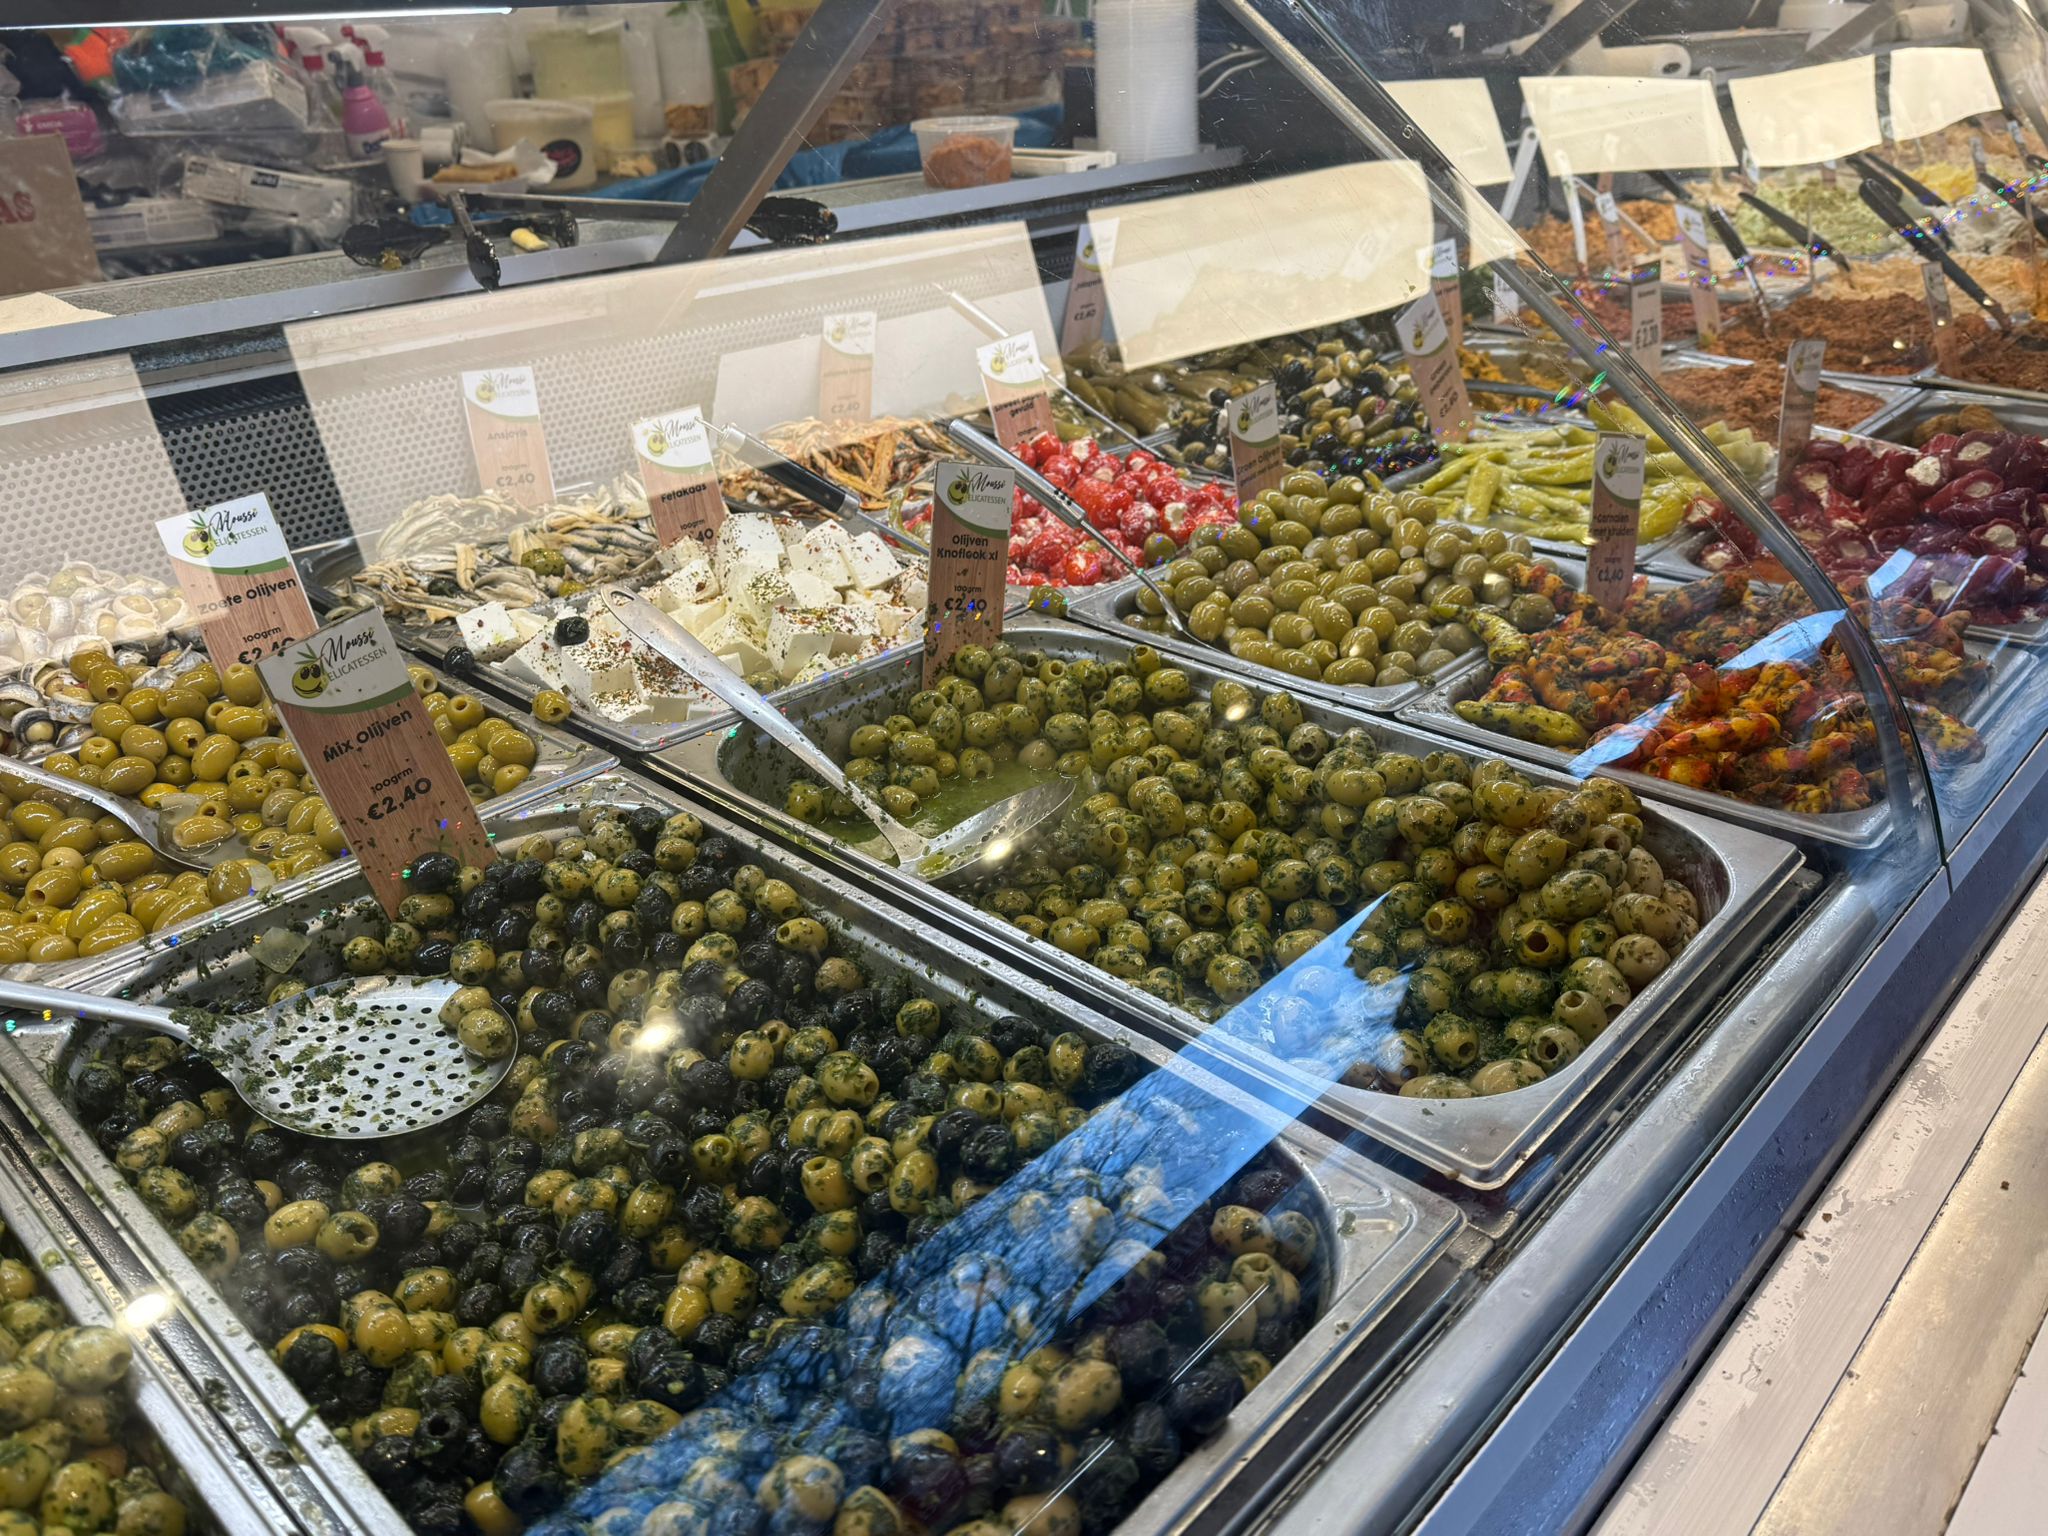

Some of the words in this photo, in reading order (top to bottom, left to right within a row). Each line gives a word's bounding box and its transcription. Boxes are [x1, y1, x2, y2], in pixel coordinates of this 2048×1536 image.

[495, 472, 536, 487] €2,40
[968, 471, 1006, 493] Moussi
[660, 482, 707, 503] Fetakaas
[208, 508, 258, 537] Moussi
[952, 535, 988, 547] Olijven
[936, 548, 987, 561] Knoflook
[197, 594, 243, 615] Zoete
[246, 577, 298, 600] Olijven
[953, 585, 982, 594] 100grm
[944, 597, 988, 613] €2,40
[242, 625, 283, 644] 100grm
[320, 628, 375, 669] Moussi
[322, 739, 355, 763] Mix
[356, 708, 413, 745] Olijven
[370, 766, 413, 795] 100grm
[366, 777, 432, 821] €2,40
